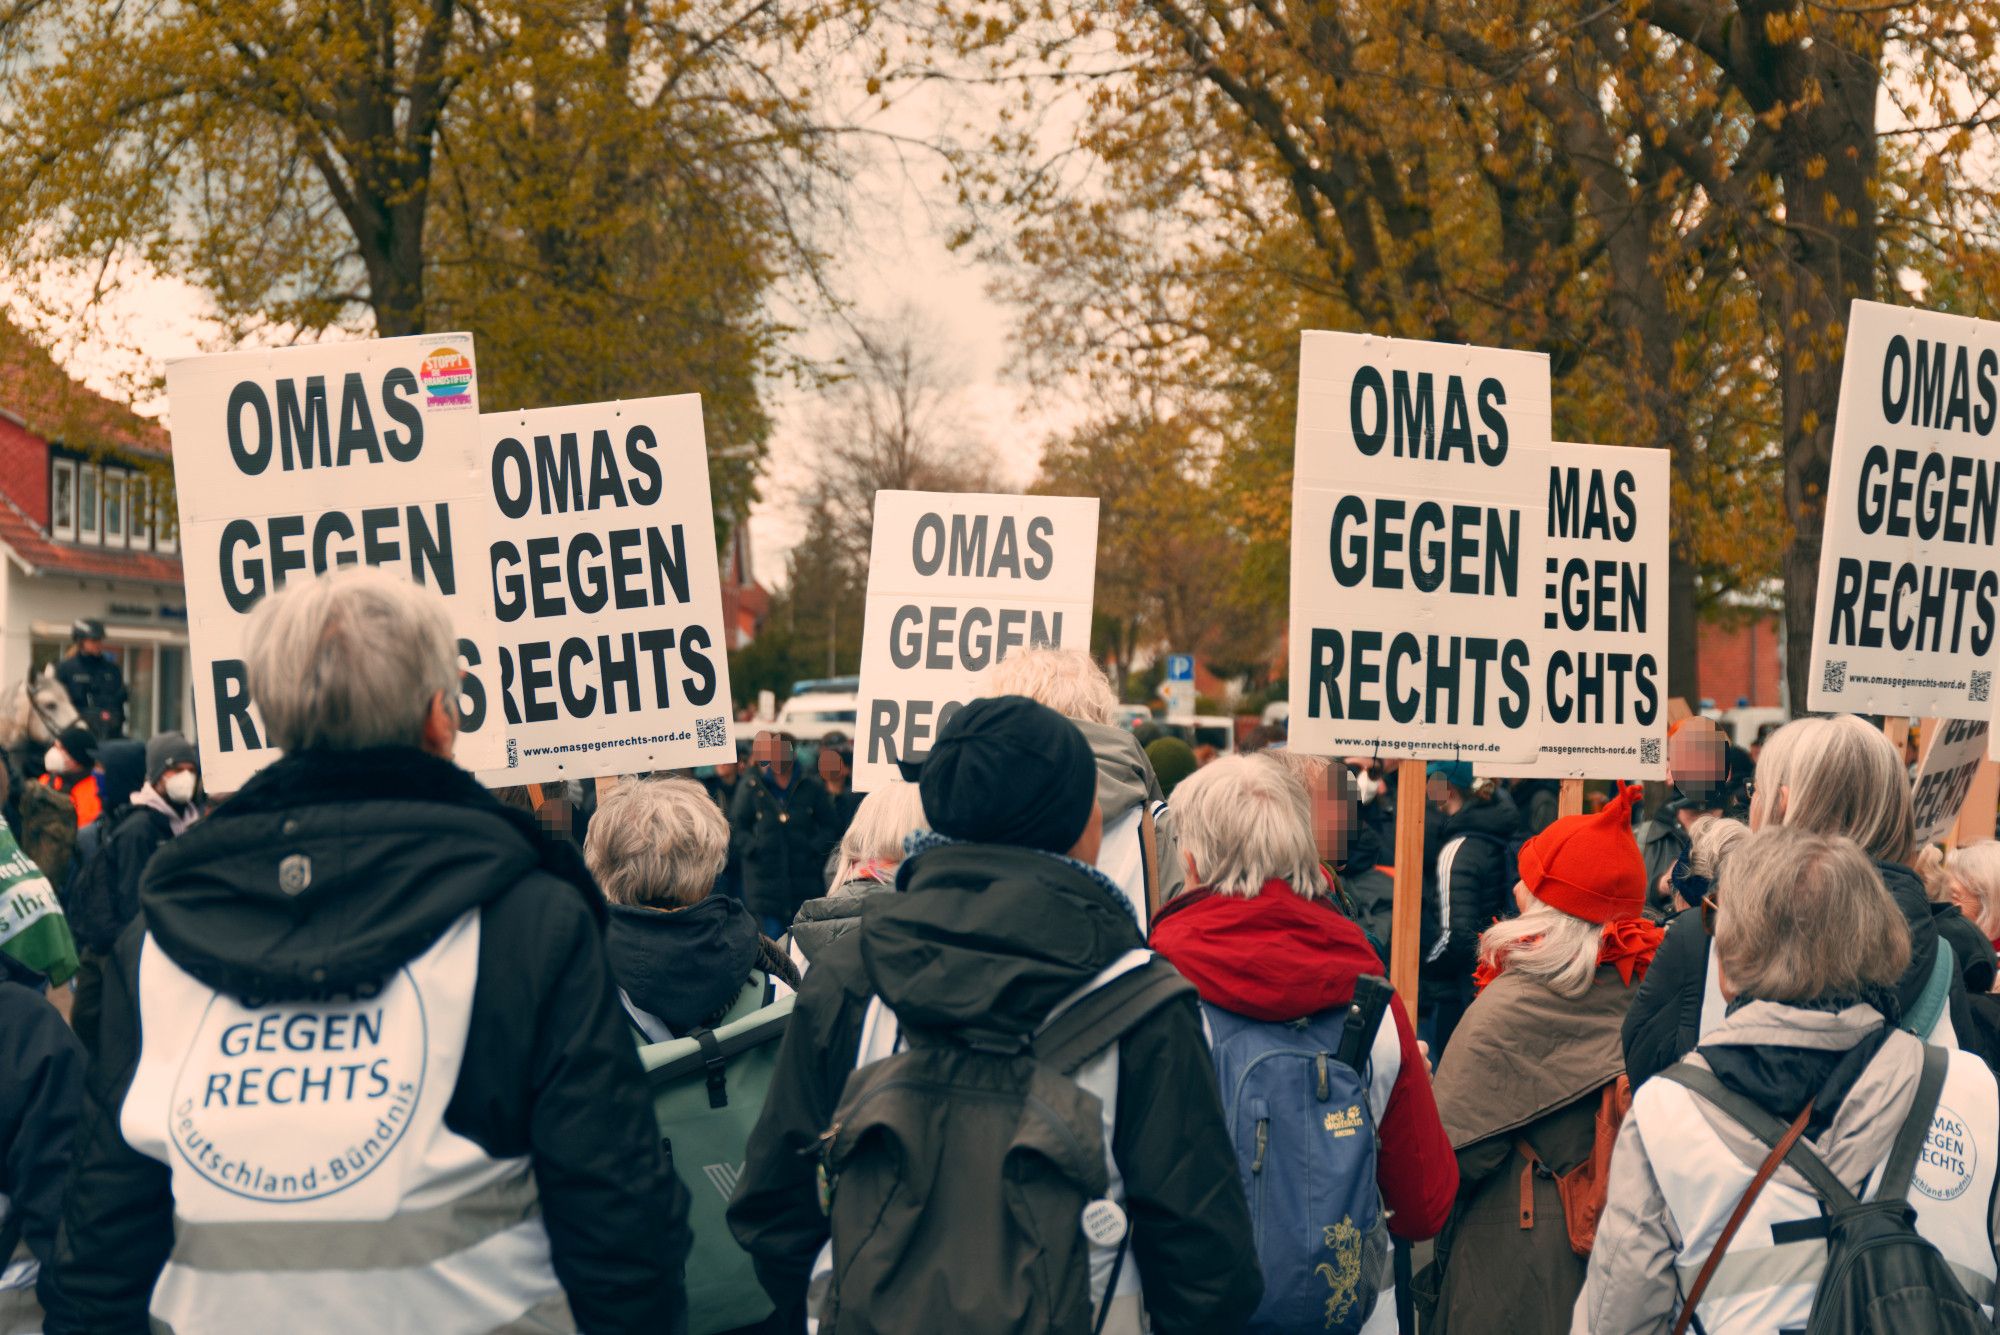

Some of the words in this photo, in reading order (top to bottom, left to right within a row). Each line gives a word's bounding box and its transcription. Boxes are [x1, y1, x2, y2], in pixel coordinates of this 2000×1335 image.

[426, 354, 463, 370] STOPPT
[1882, 335, 1999, 436] OMAS
[226, 368, 425, 476] OMAS
[1350, 365, 1509, 467] OMAS
[491, 425, 663, 519] OMAS
[1547, 466, 1637, 543] MAS
[1857, 444, 2000, 546] GEGEN
[219, 503, 456, 614] GEGEN
[489, 524, 692, 623] GEGEN
[911, 512, 1054, 581] OMAS
[1330, 495, 1521, 598] GEGEN
[1544, 557, 1648, 634] EGEN
[1829, 558, 1997, 656] RECHTS
[499, 625, 717, 725] RECHTS
[889, 604, 1064, 672] GEGEN
[1308, 627, 1531, 730] RECHTS
[1546, 650, 1659, 727] CHTS
[523, 731, 692, 757] www.omasgegenrechts-nord.de
[1334, 736, 1501, 754] www.omasgegenrechts-nord.de
[1539, 744, 1638, 757] masgegenrechts-nord.de
[219, 1008, 383, 1057] GEGEN
[203, 1058, 390, 1108] RECHTS
[177, 1088, 413, 1193] Deutschland-Bündnis
[1922, 1149, 1966, 1176] ECHTS
[1925, 1131, 1964, 1156] EGEN
[1934, 1117, 1962, 1136] MAS
